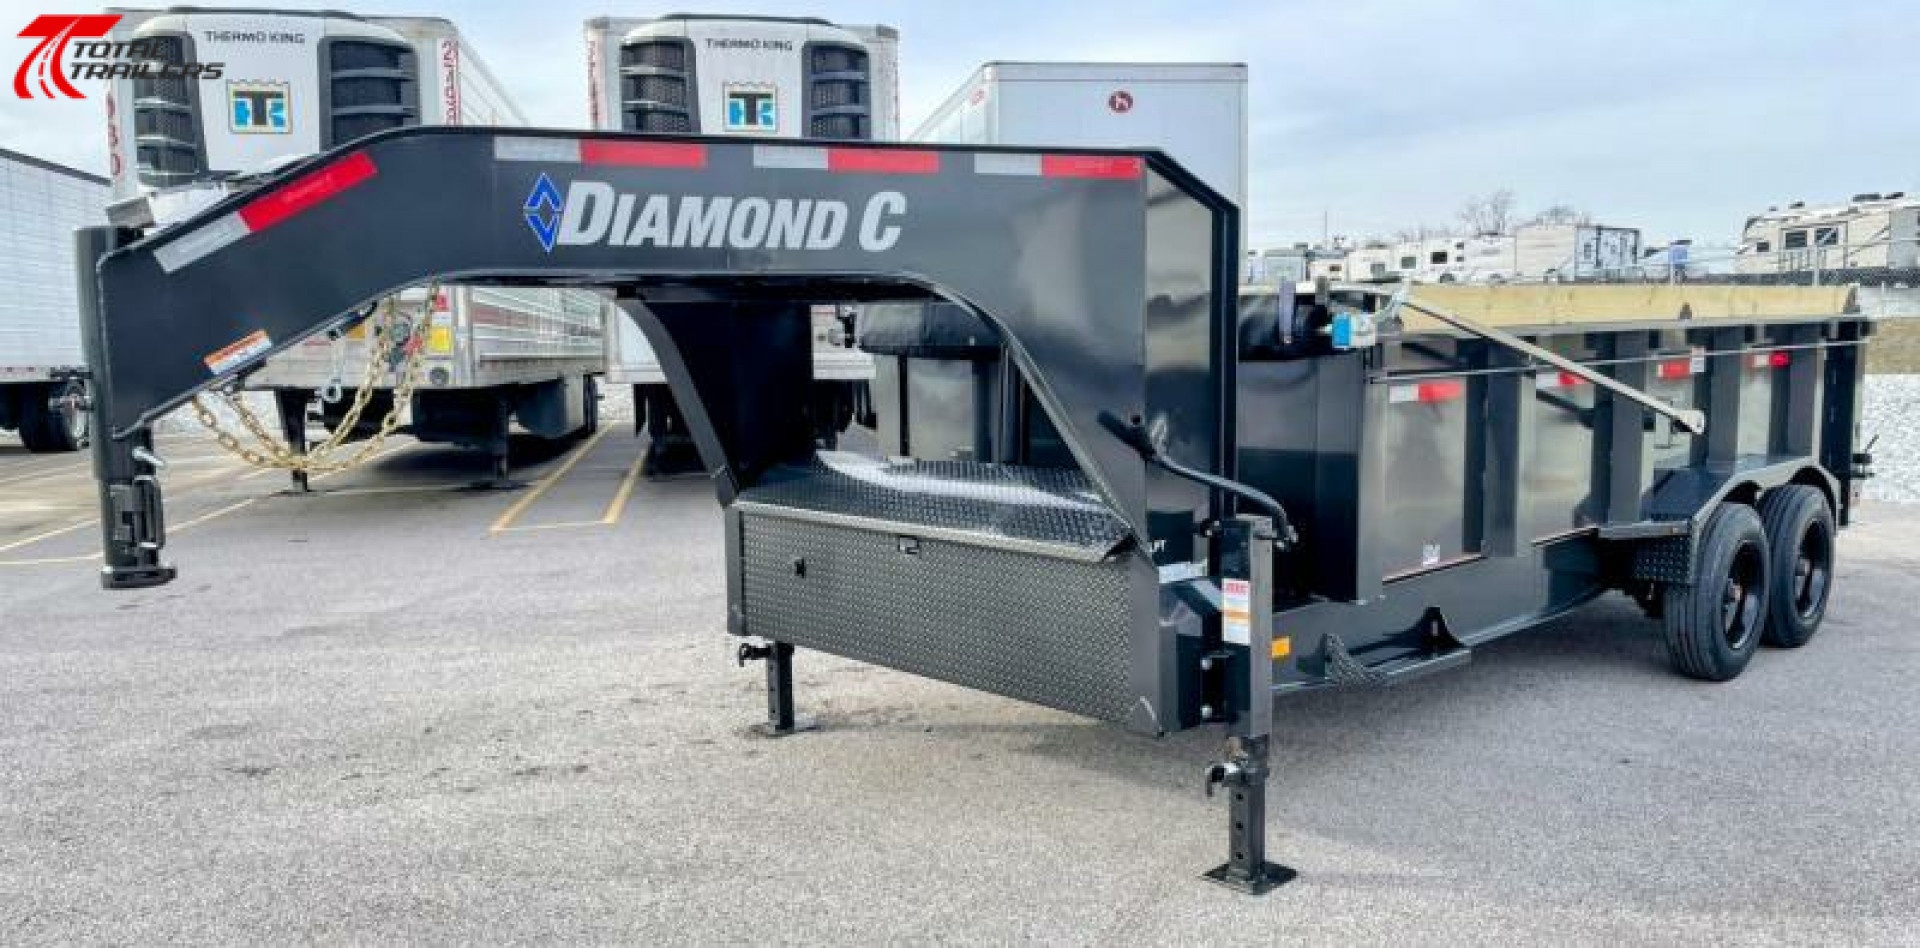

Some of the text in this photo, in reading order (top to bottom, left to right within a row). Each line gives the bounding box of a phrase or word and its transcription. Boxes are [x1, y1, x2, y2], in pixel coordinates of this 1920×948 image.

[204, 30, 306, 44] THERMO KING
[706, 37, 793, 51] THERMO KING
[557, 180, 908, 252] DIAMOND C
